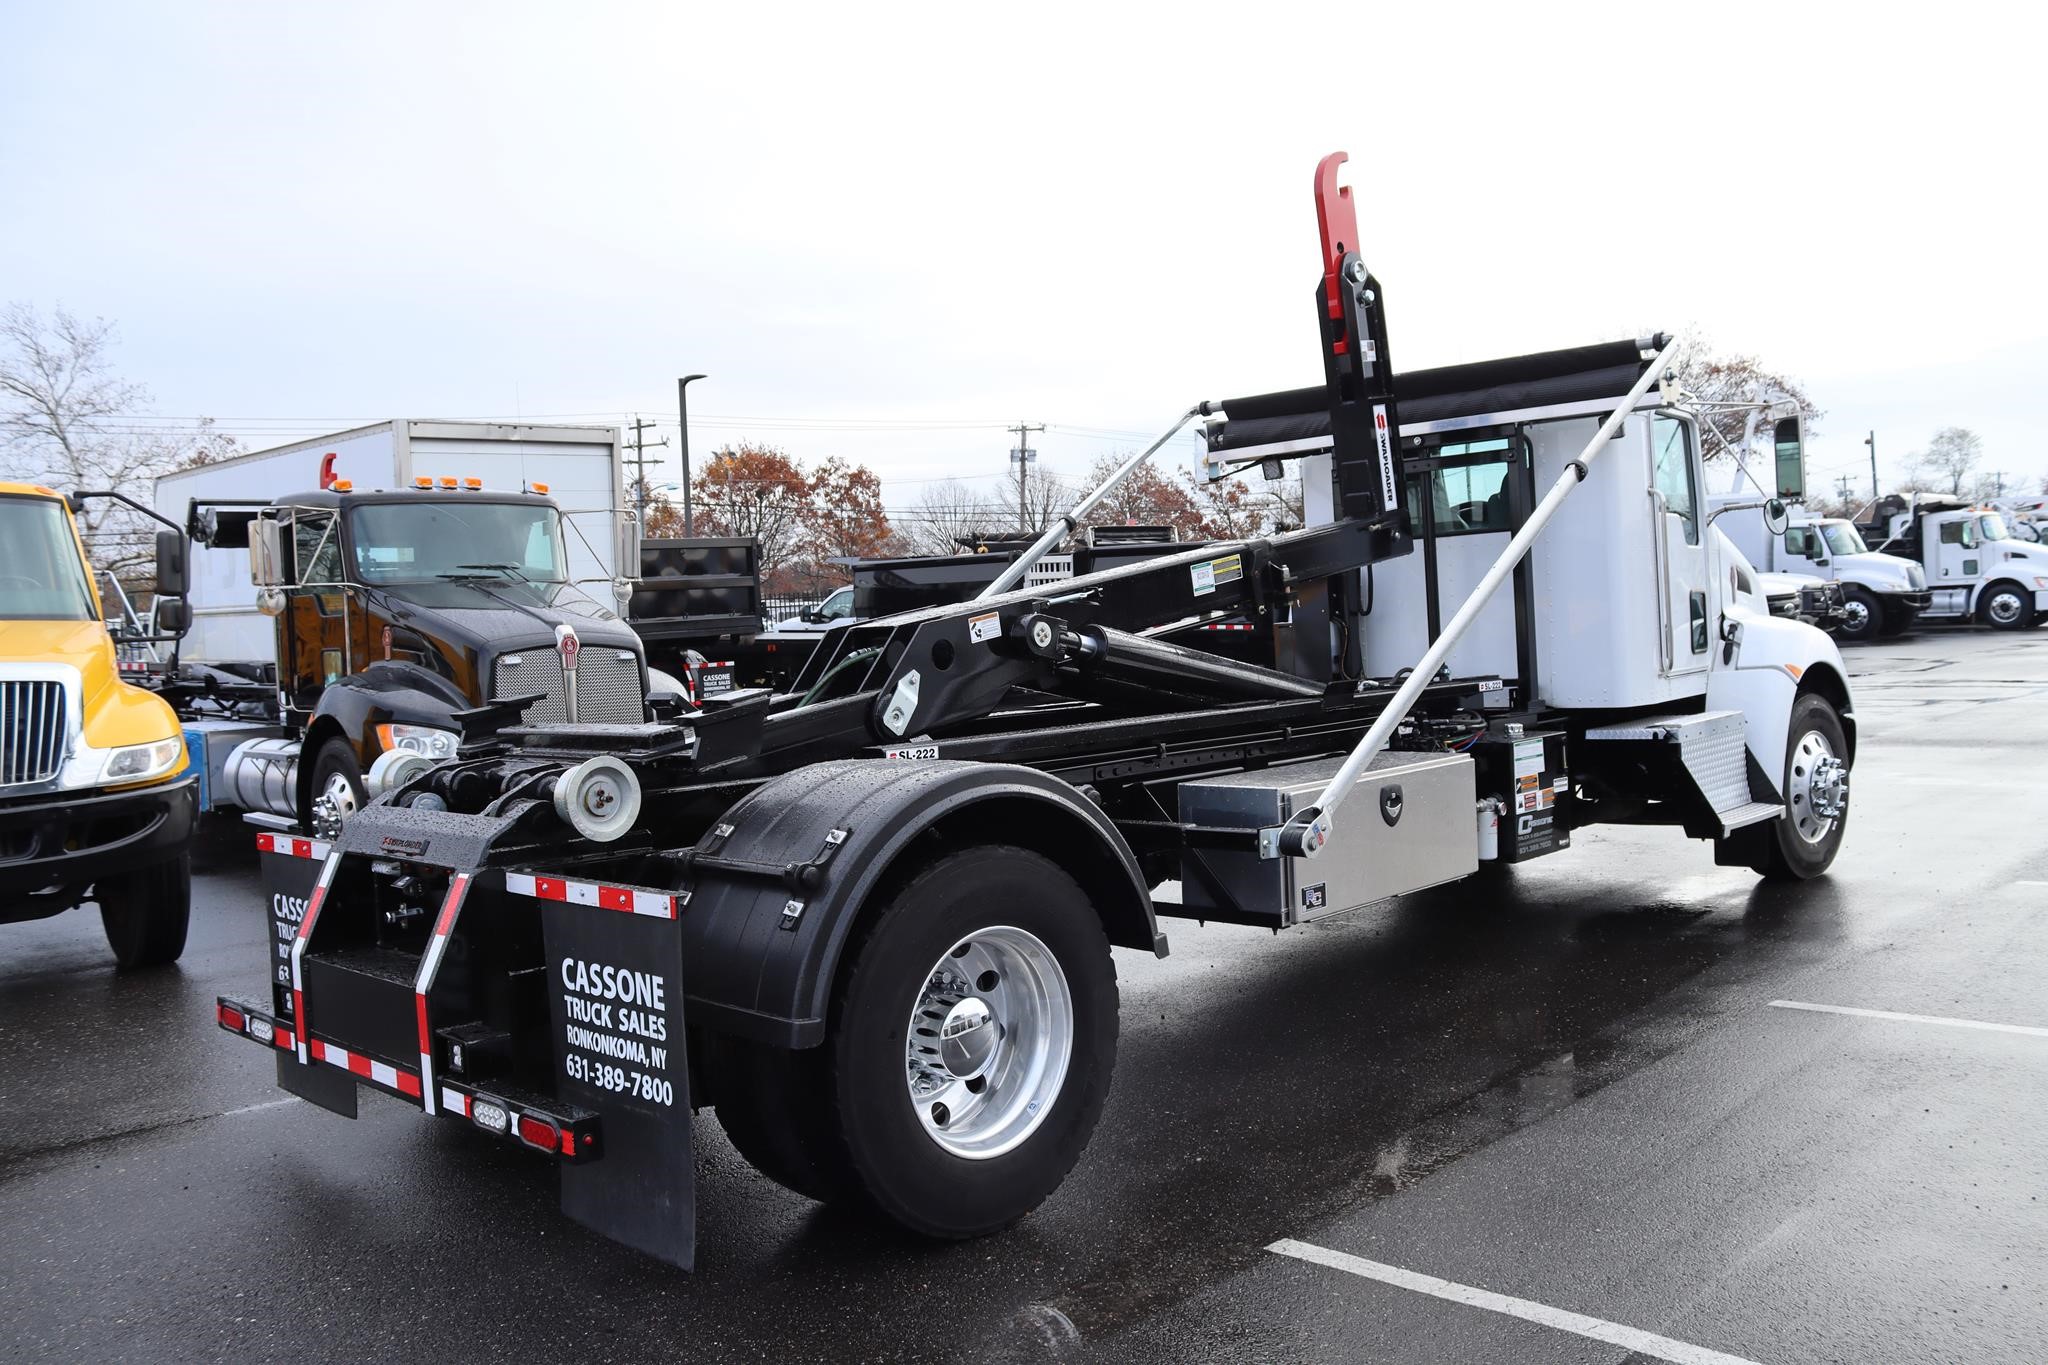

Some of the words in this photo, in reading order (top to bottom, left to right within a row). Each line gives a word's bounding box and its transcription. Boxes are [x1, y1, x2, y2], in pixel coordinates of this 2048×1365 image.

[1379, 432, 1393, 502] SWAPLOADER
[703, 673, 730, 681] CASSONE
[899, 748, 935, 760] SL-222
[274, 893, 308, 922] CASS
[561, 957, 666, 1011] CASSONE
[564, 994, 613, 1029] TRUCK
[618, 1008, 667, 1041] SALES
[566, 1024, 650, 1068] RONKONKOMA,
[651, 1046, 667, 1070] NY
[566, 1053, 673, 1107] 631-389-7800
